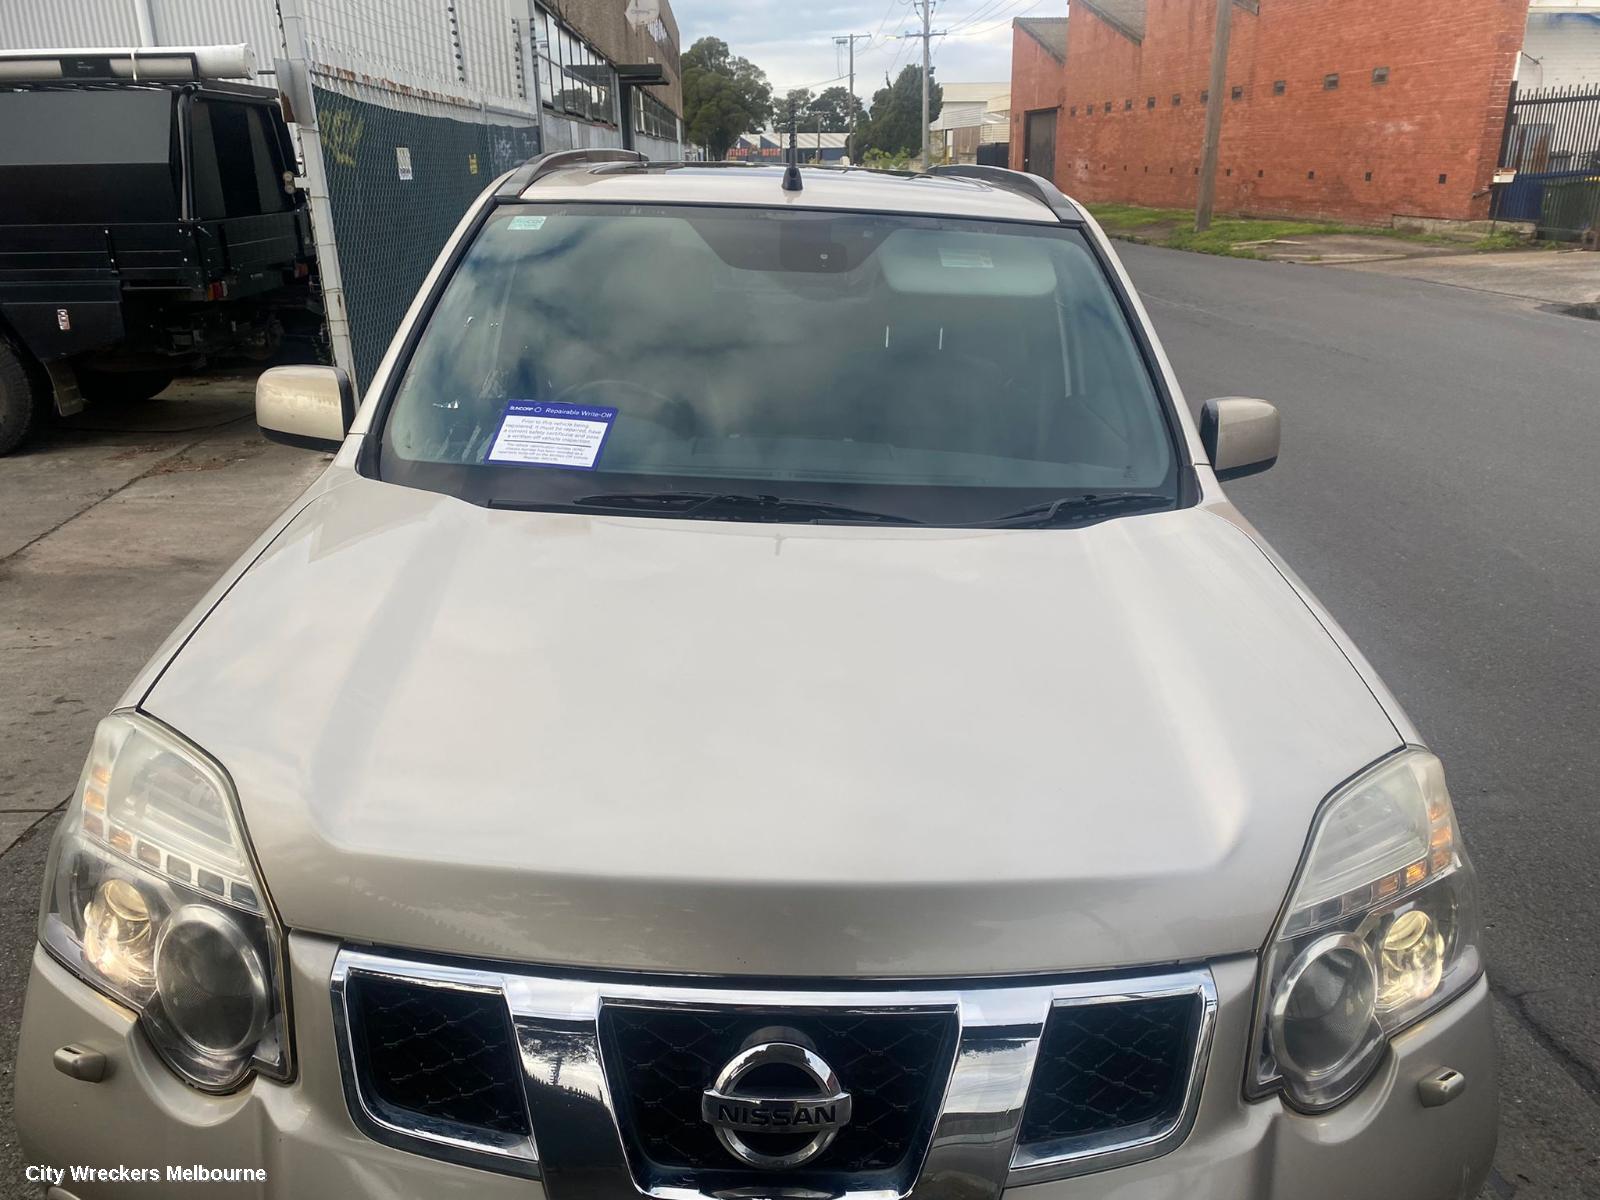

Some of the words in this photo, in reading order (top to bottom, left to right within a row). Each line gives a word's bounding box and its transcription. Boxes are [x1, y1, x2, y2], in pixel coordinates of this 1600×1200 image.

[545, 407, 579, 416] Repairable
[581, 410, 612, 418] Write-Off
[718, 1105, 836, 1125] NISSAN
